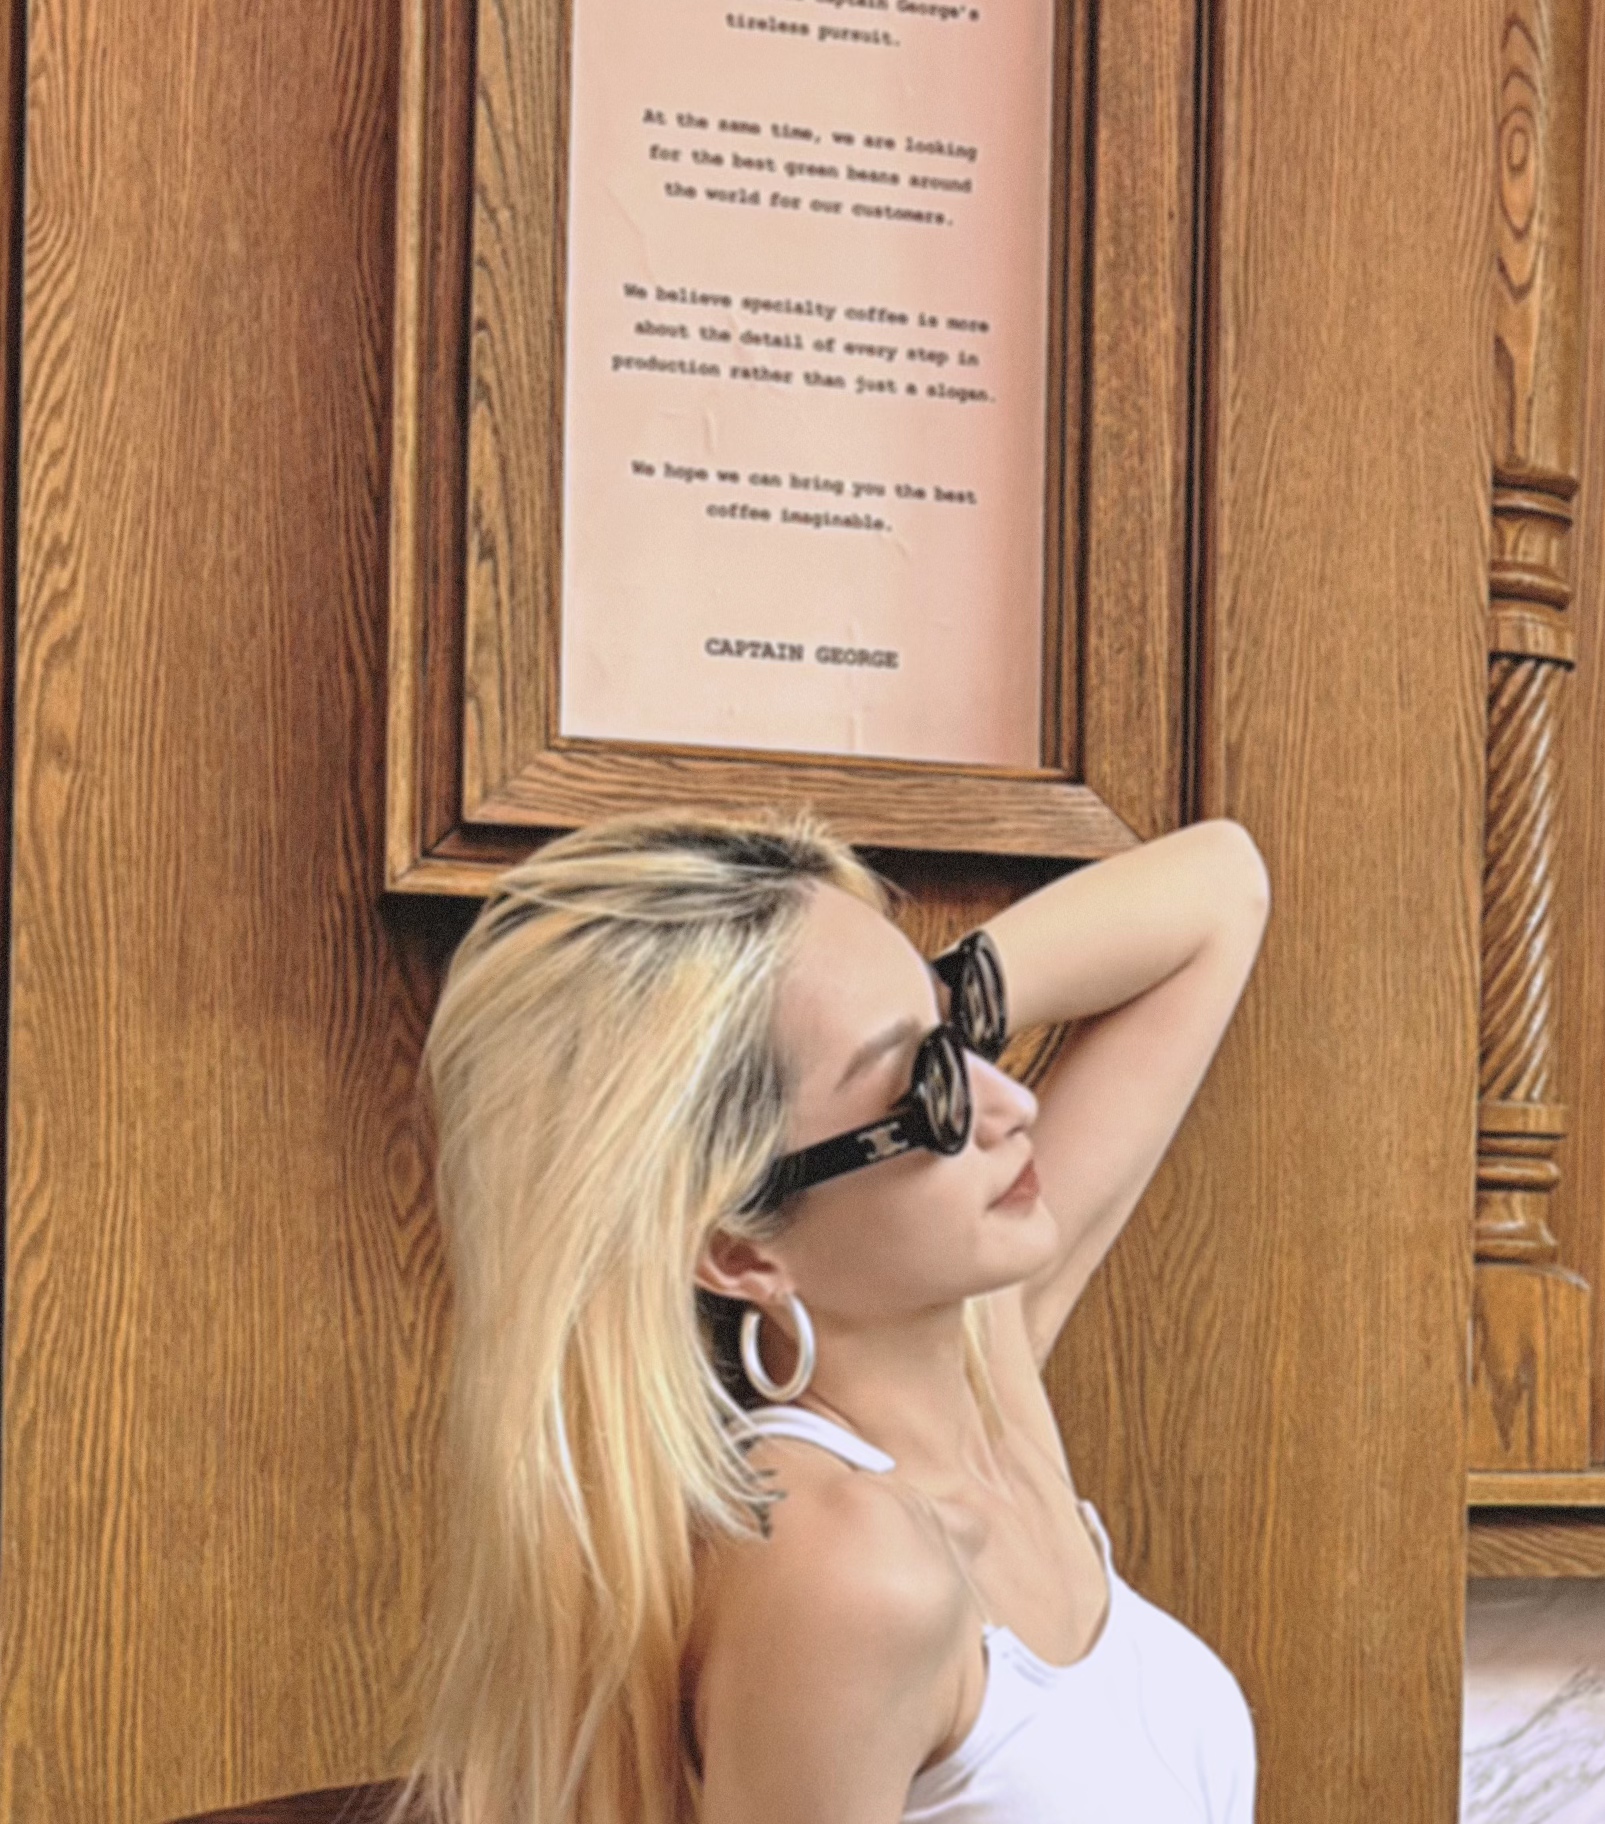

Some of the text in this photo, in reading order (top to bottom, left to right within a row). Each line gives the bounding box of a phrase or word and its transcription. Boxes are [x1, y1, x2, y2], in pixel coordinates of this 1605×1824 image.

[725, 13, 899, 47] tireless pursuit.
[642, 108, 978, 162] At the same time, we are looking
[649, 144, 973, 193] for the best green beans around
[664, 182, 954, 226] the world for our customers.
[623, 283, 990, 333] We believe specialty coffee is more
[634, 320, 979, 367] about the detail of every step in
[611, 355, 997, 404] production rather than just a slogan.
[631, 460, 977, 505] We hope we can bring you the best
[706, 503, 892, 532] coffee imaginable.
[704, 637, 899, 669] CAPTAIN GEORGE
